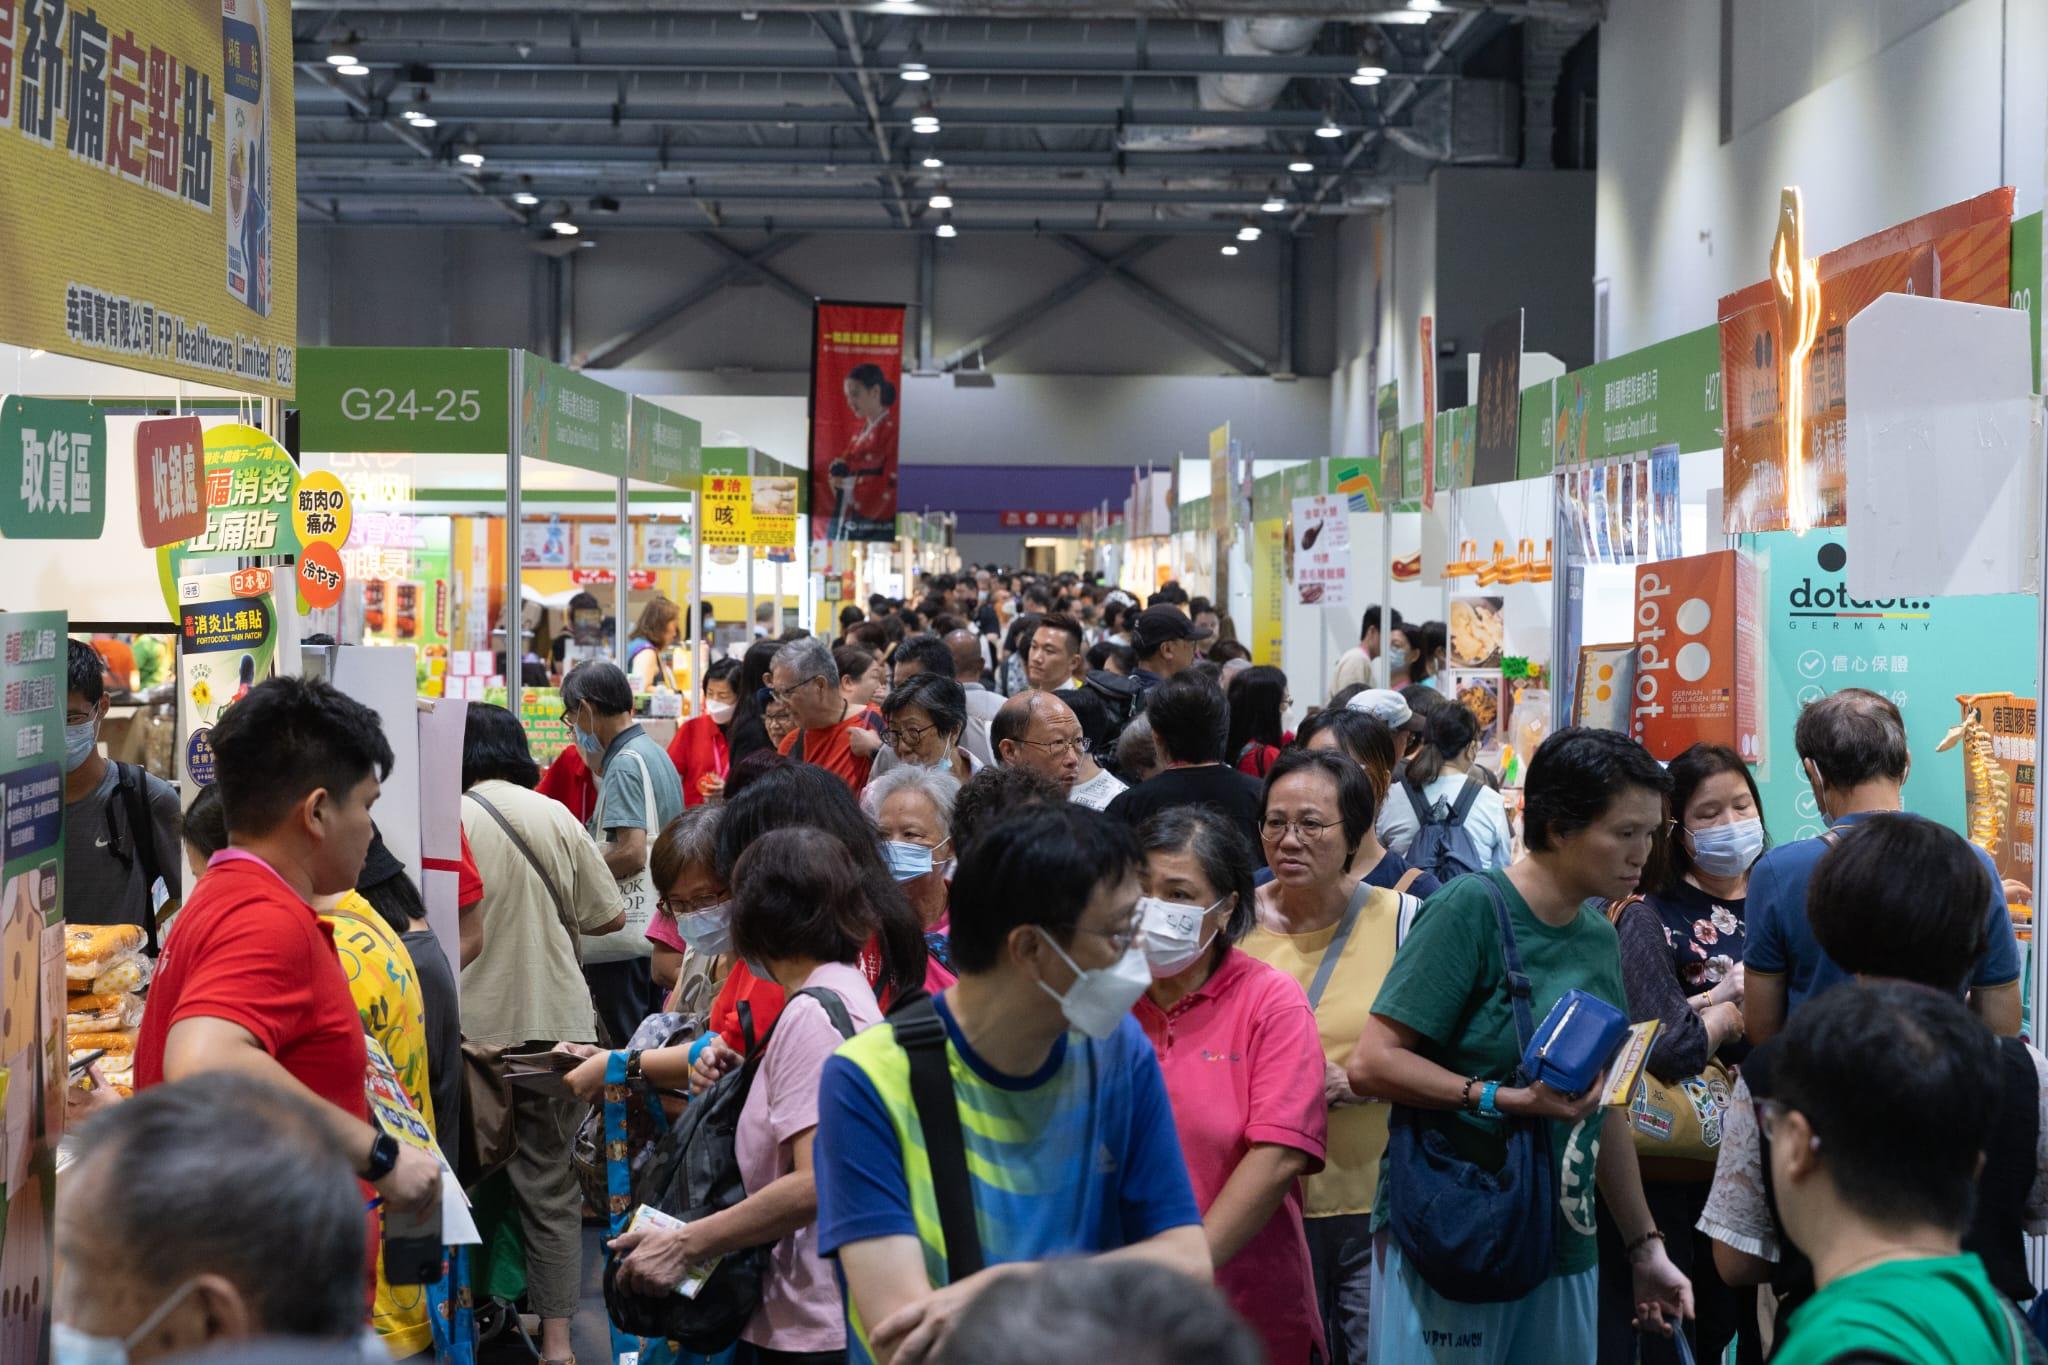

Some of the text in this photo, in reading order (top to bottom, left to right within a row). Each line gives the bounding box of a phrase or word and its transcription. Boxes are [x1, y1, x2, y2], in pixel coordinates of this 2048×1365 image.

[158, 315, 172, 355] FP
[176, 321, 233, 371] Healthcare
[236, 336, 271, 379] Limited
[276, 348, 292, 384] G23
[341, 388, 481, 421] G24-25
[1705, 371, 1720, 412] H27
[20, 428, 92, 514] 取貨區
[152, 442, 198, 524] 收銀處
[299, 490, 343, 511] 筋肉の
[307, 514, 336, 534] 痛み
[715, 506, 734, 525] 咳
[187, 510, 279, 552] 止痛貼
[234, 571, 267, 593] 日本製
[304, 560, 339, 588] 冷やす
[195, 610, 262, 635] 消炎止痛貼
[1789, 622, 1930, 631] GERMANY
[1832, 655, 1909, 672] 信心保證
